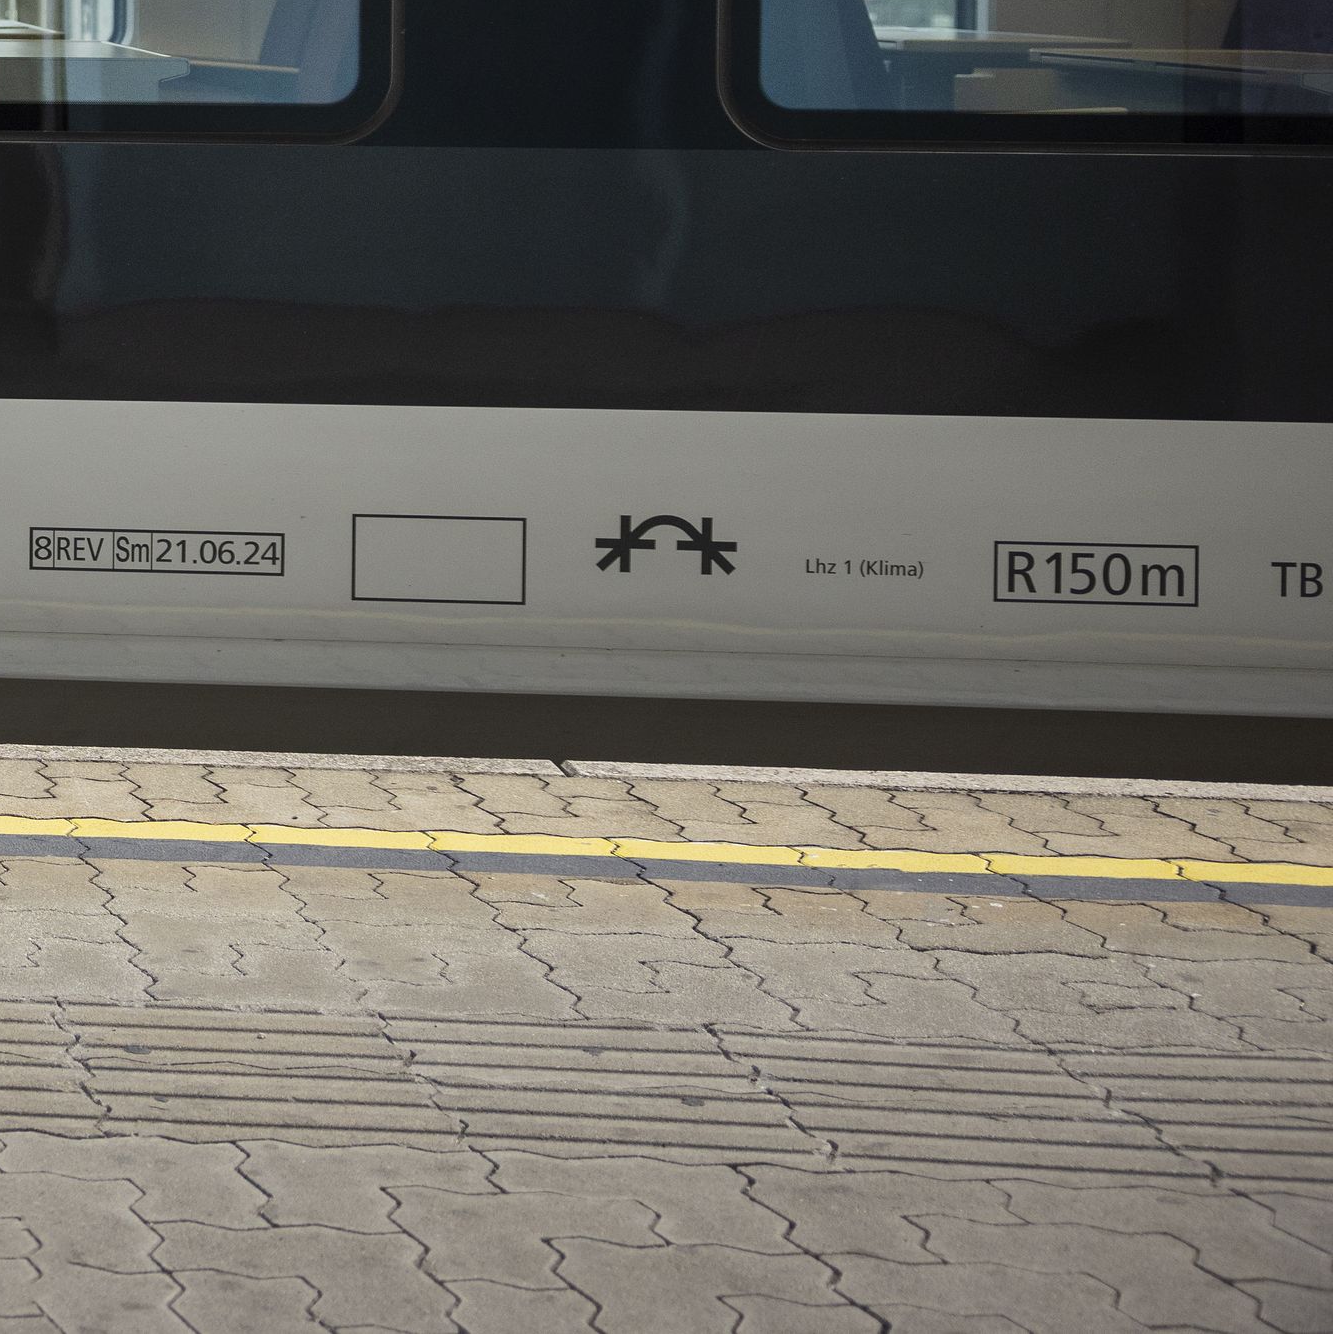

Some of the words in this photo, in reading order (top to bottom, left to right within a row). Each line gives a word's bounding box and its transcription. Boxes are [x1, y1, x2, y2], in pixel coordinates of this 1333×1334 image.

[35, 536, 52, 560] 8
[57, 537, 104, 561] REV
[116, 536, 150, 562] Sm
[156, 538, 280, 565] 21.06.24
[807, 559, 836, 574] Lhz
[845, 561, 850, 574] 1
[860, 560, 923, 579] (Klima)
